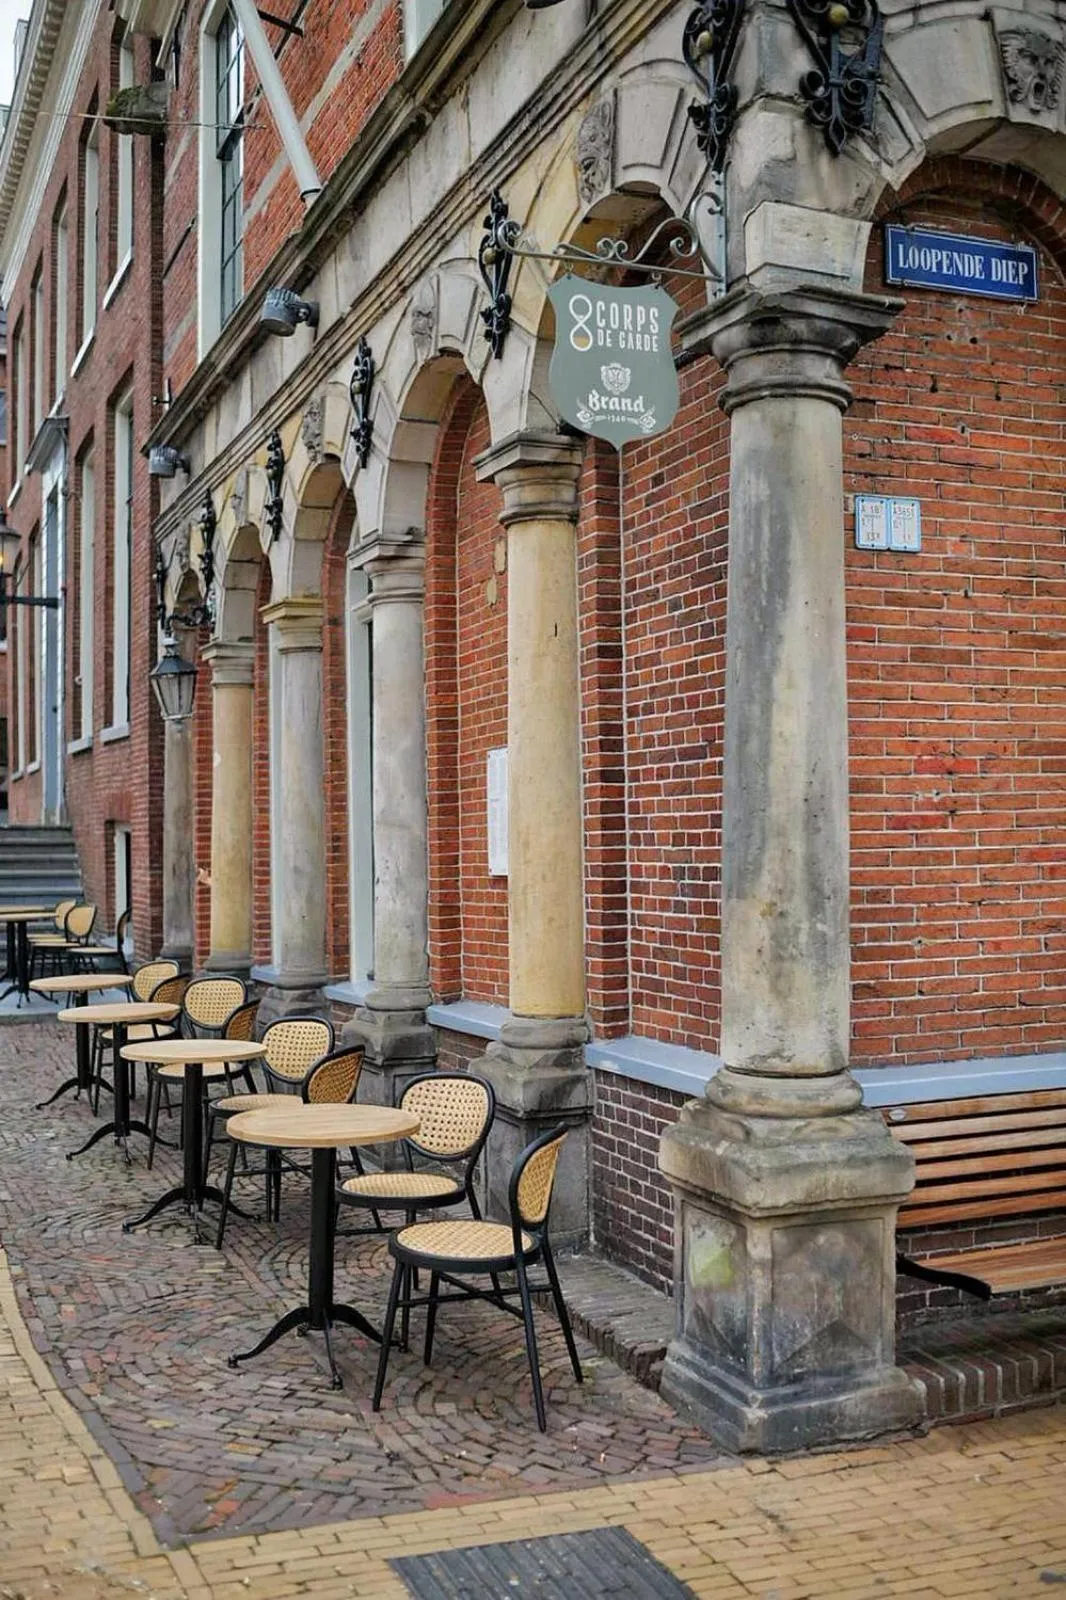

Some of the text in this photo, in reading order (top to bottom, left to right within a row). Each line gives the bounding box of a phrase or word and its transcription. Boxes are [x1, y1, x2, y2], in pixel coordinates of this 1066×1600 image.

[898, 243, 1029, 285] LOOPENDE DIEP
[596, 300, 659, 334] CORPS
[597, 328, 659, 352] DE GARDE
[588, 389, 645, 412] Brand
